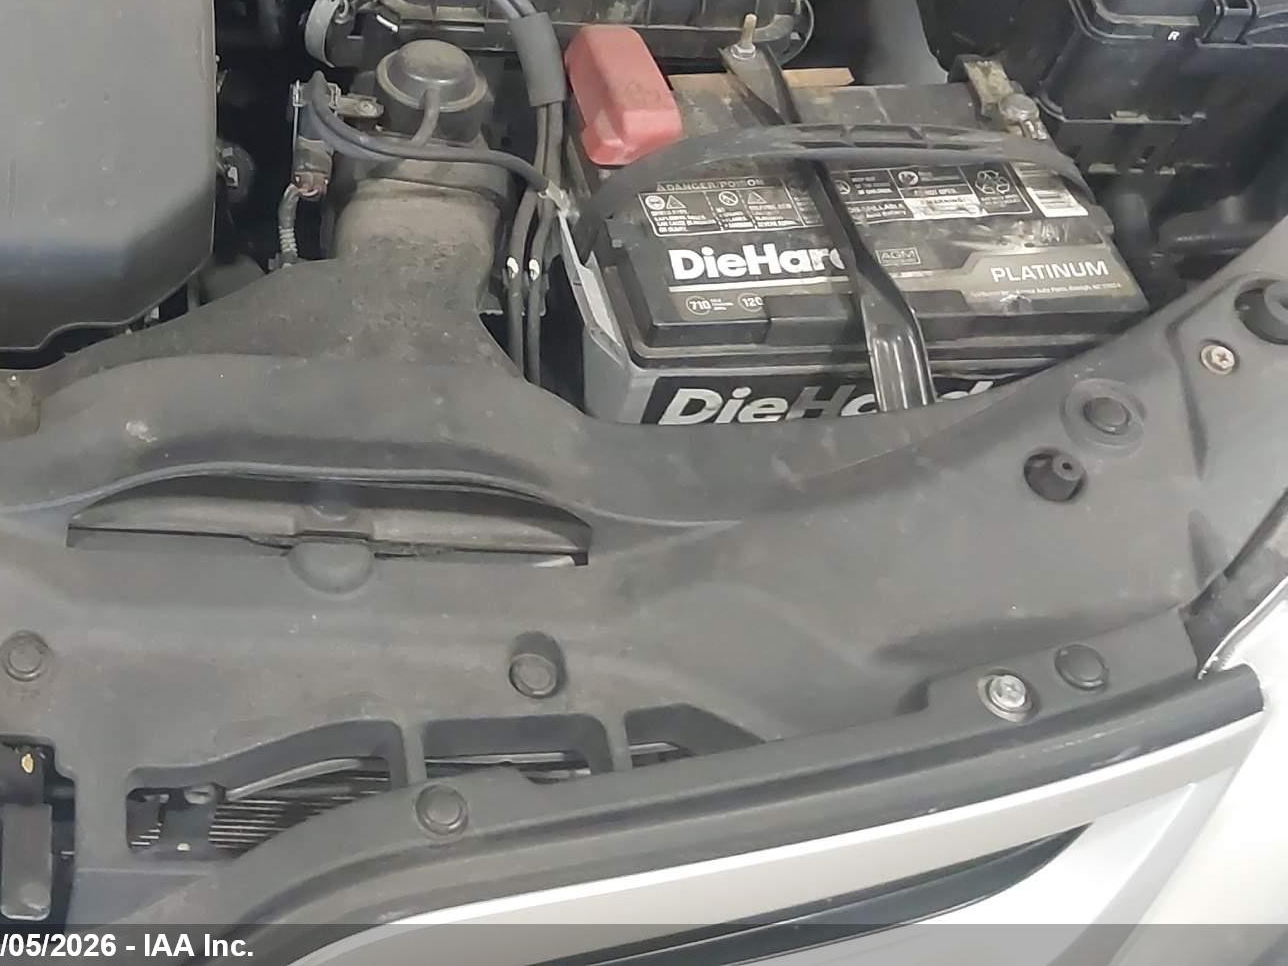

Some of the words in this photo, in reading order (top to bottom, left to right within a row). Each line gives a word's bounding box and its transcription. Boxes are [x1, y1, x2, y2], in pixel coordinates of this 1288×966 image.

[990, 260, 1109, 283] PLATINUM
[689, 300, 712, 310] 710
[658, 381, 994, 425] DieHa
